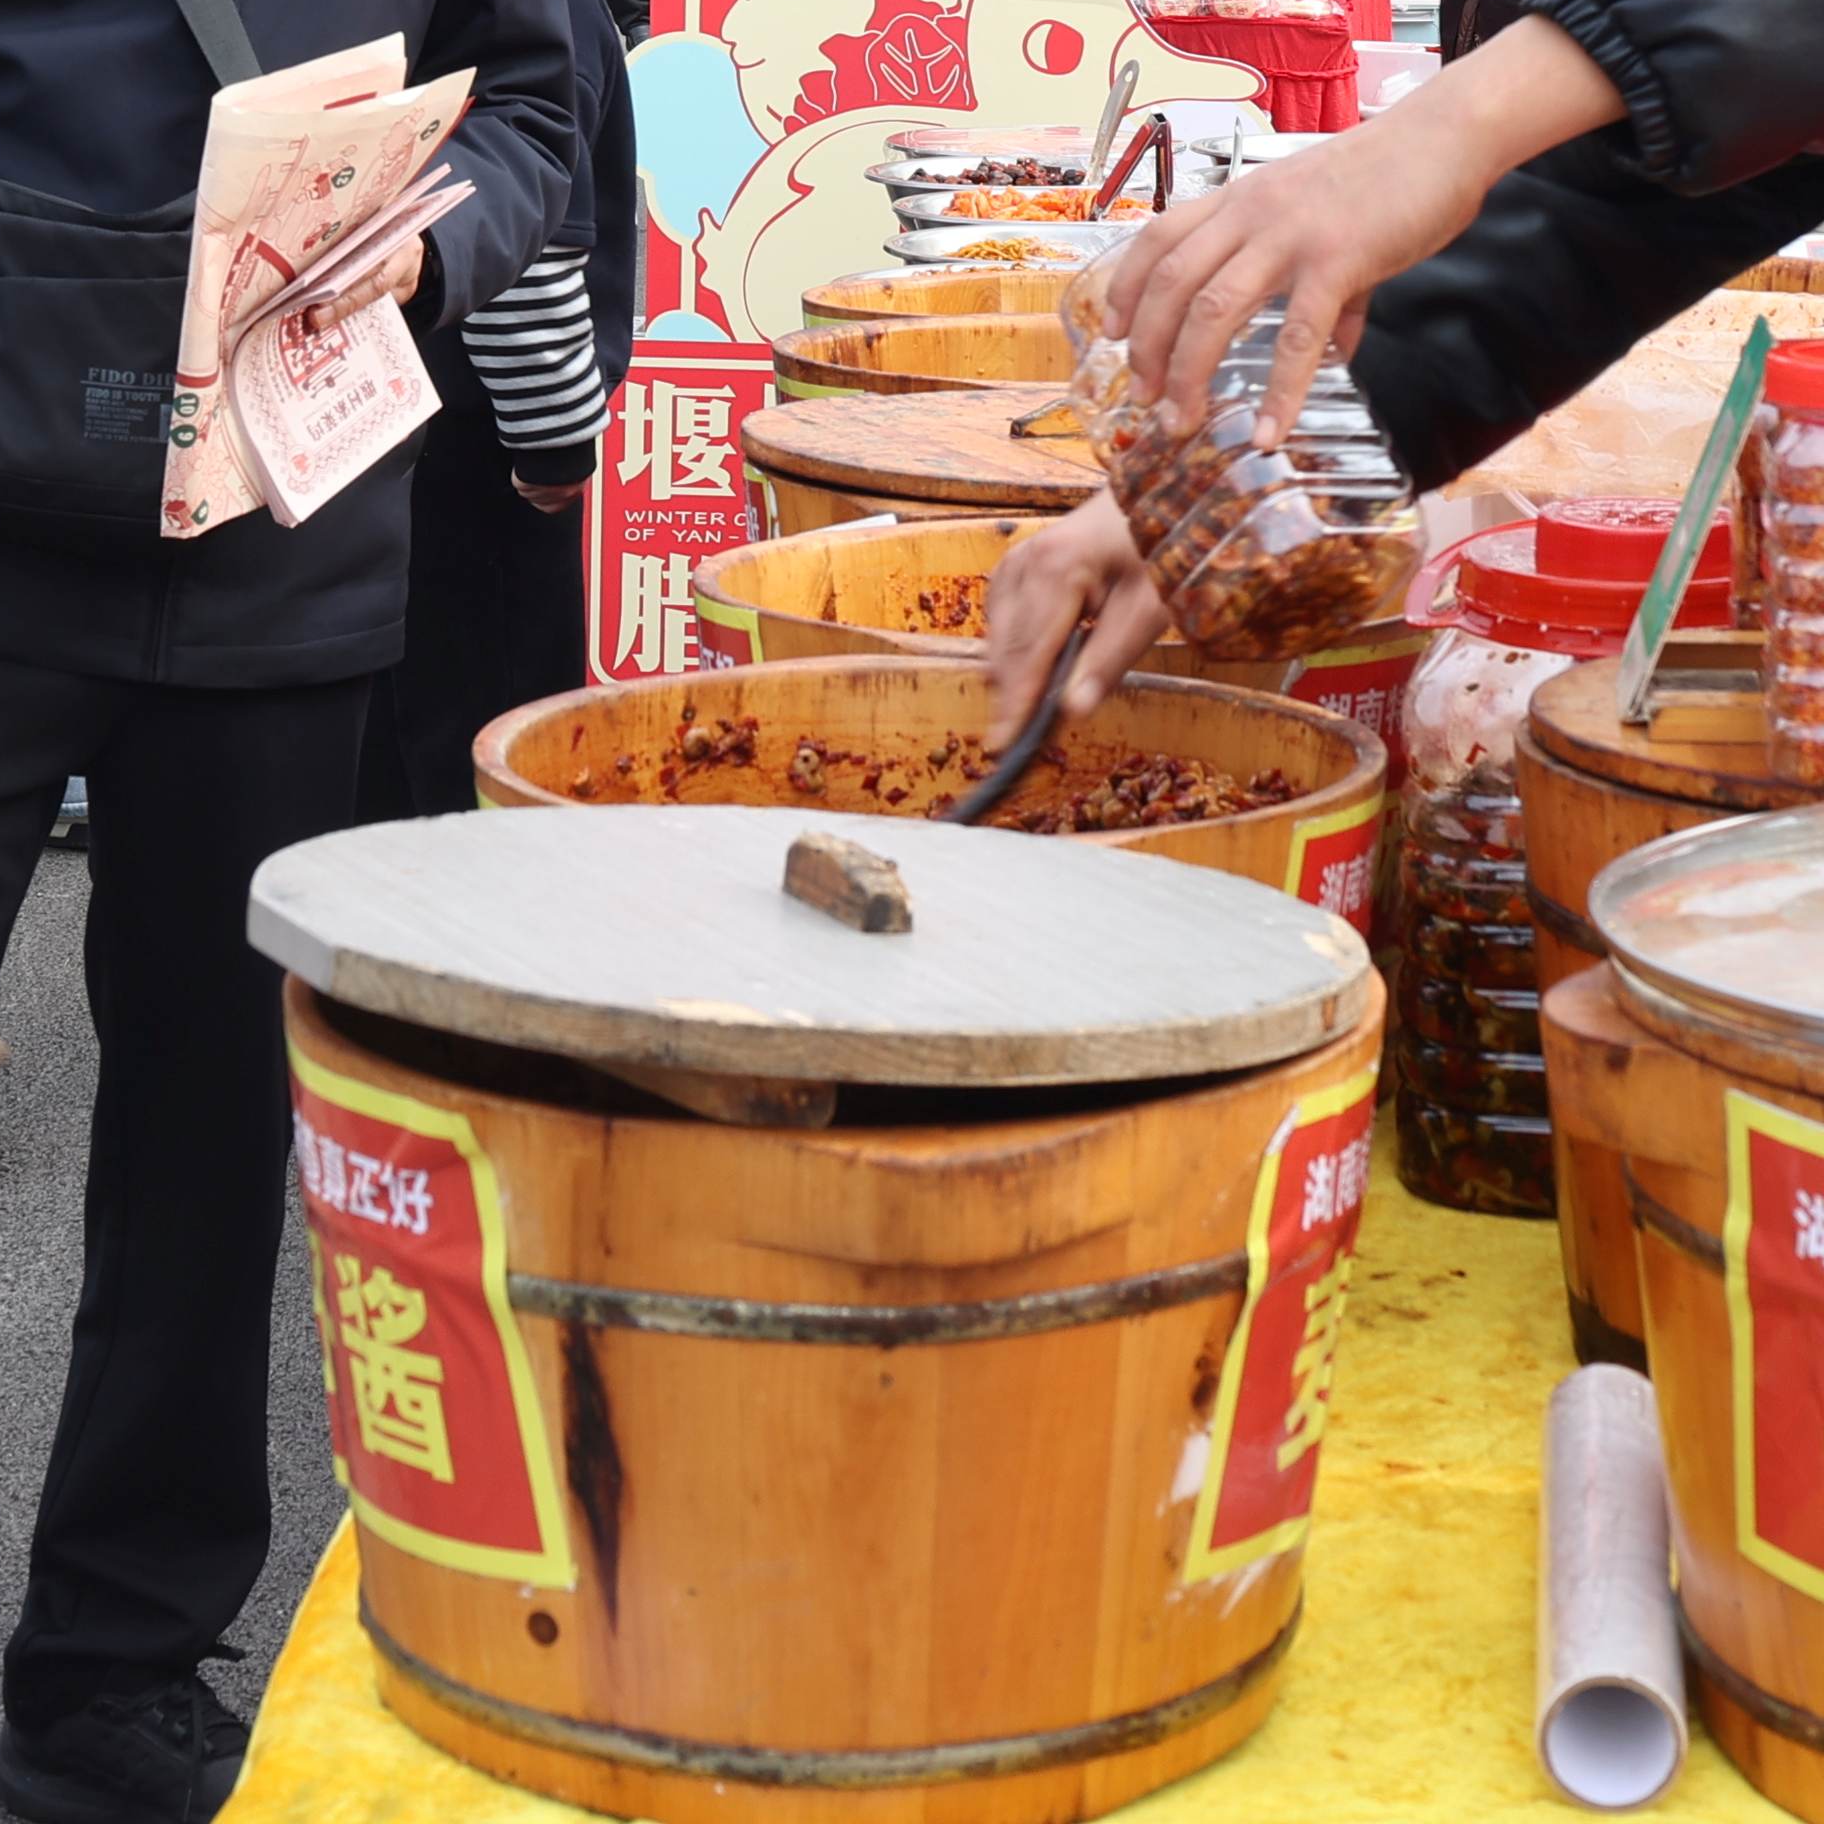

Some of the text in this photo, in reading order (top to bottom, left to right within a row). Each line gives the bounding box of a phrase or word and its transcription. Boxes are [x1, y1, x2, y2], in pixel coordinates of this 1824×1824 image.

[87, 367, 136, 385] FIDO
[616, 379, 751, 501] 堰
[624, 510, 726, 526] WINTER
[624, 528, 656, 542] OF
[671, 529, 722, 543] YAN
[316, 1241, 456, 1485] 酱
